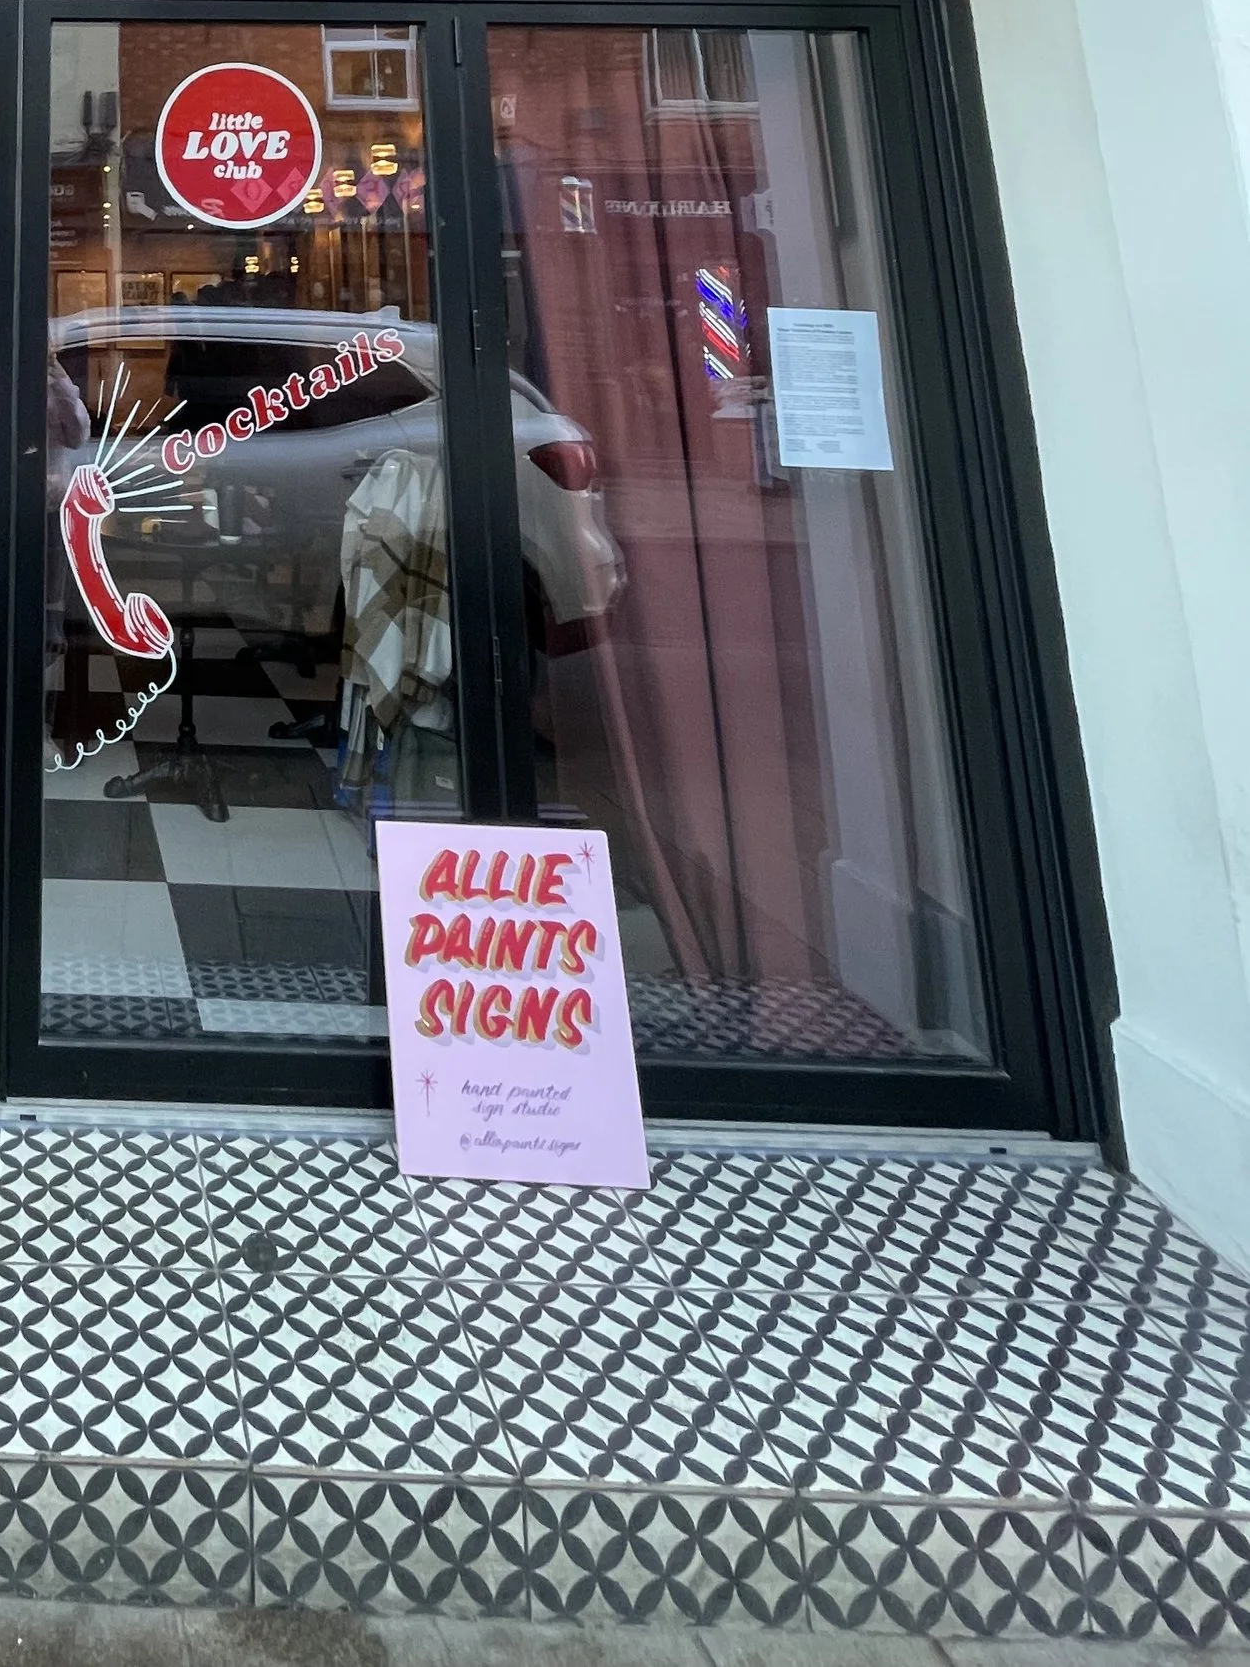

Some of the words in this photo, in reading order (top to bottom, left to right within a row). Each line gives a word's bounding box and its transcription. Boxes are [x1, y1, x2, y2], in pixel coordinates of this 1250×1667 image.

[208, 112, 264, 131] little
[182, 130, 291, 160] LOVE
[213, 160, 263, 180] club
[162, 328, 405, 474] Cocktails
[419, 848, 574, 909] ALLIE
[405, 912, 598, 975] PAINTS
[414, 978, 593, 1050] SIGNS
[460, 1078, 503, 1097] hand
[505, 1083, 573, 1102] painted
[471, 1100, 505, 1122] sign
[511, 1099, 561, 1117] studio
